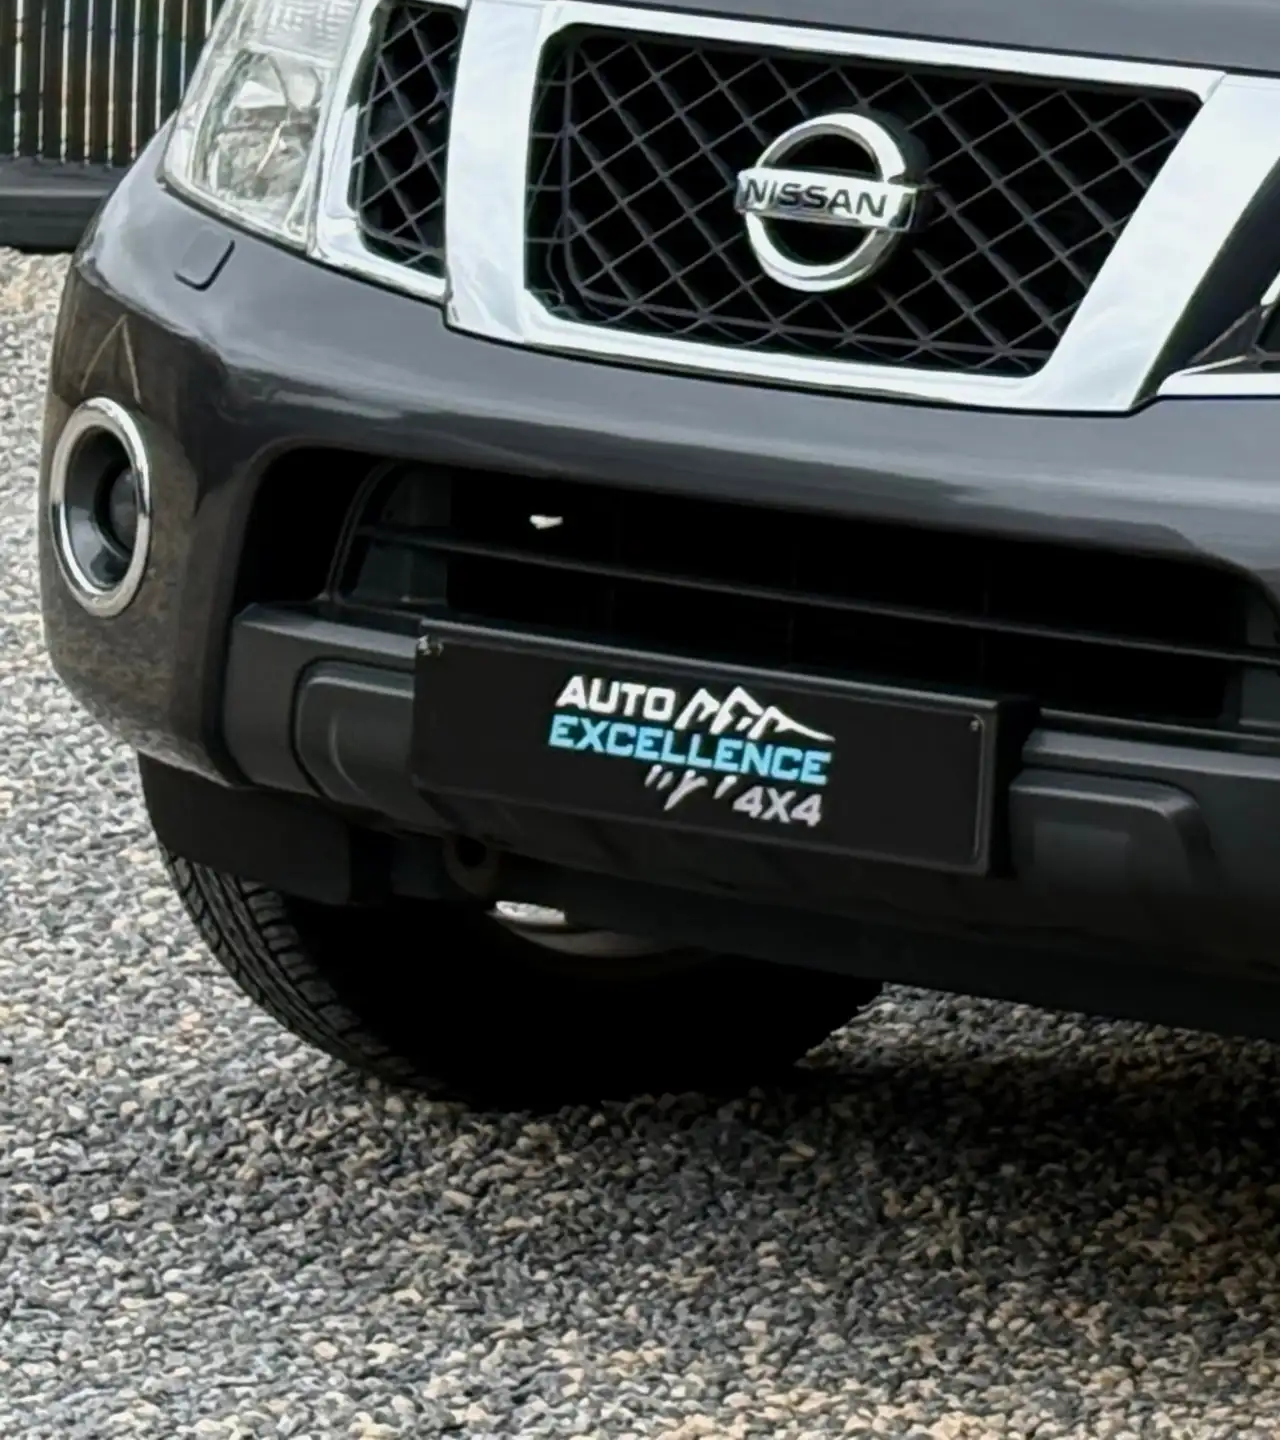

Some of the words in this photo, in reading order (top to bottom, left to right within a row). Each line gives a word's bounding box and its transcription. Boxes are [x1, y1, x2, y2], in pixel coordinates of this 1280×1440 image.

[744, 178, 888, 218] NISSAN
[556, 674, 676, 722] AUTO
[547, 713, 832, 786] EXCELLENCE
[732, 784, 823, 827] 4X4
